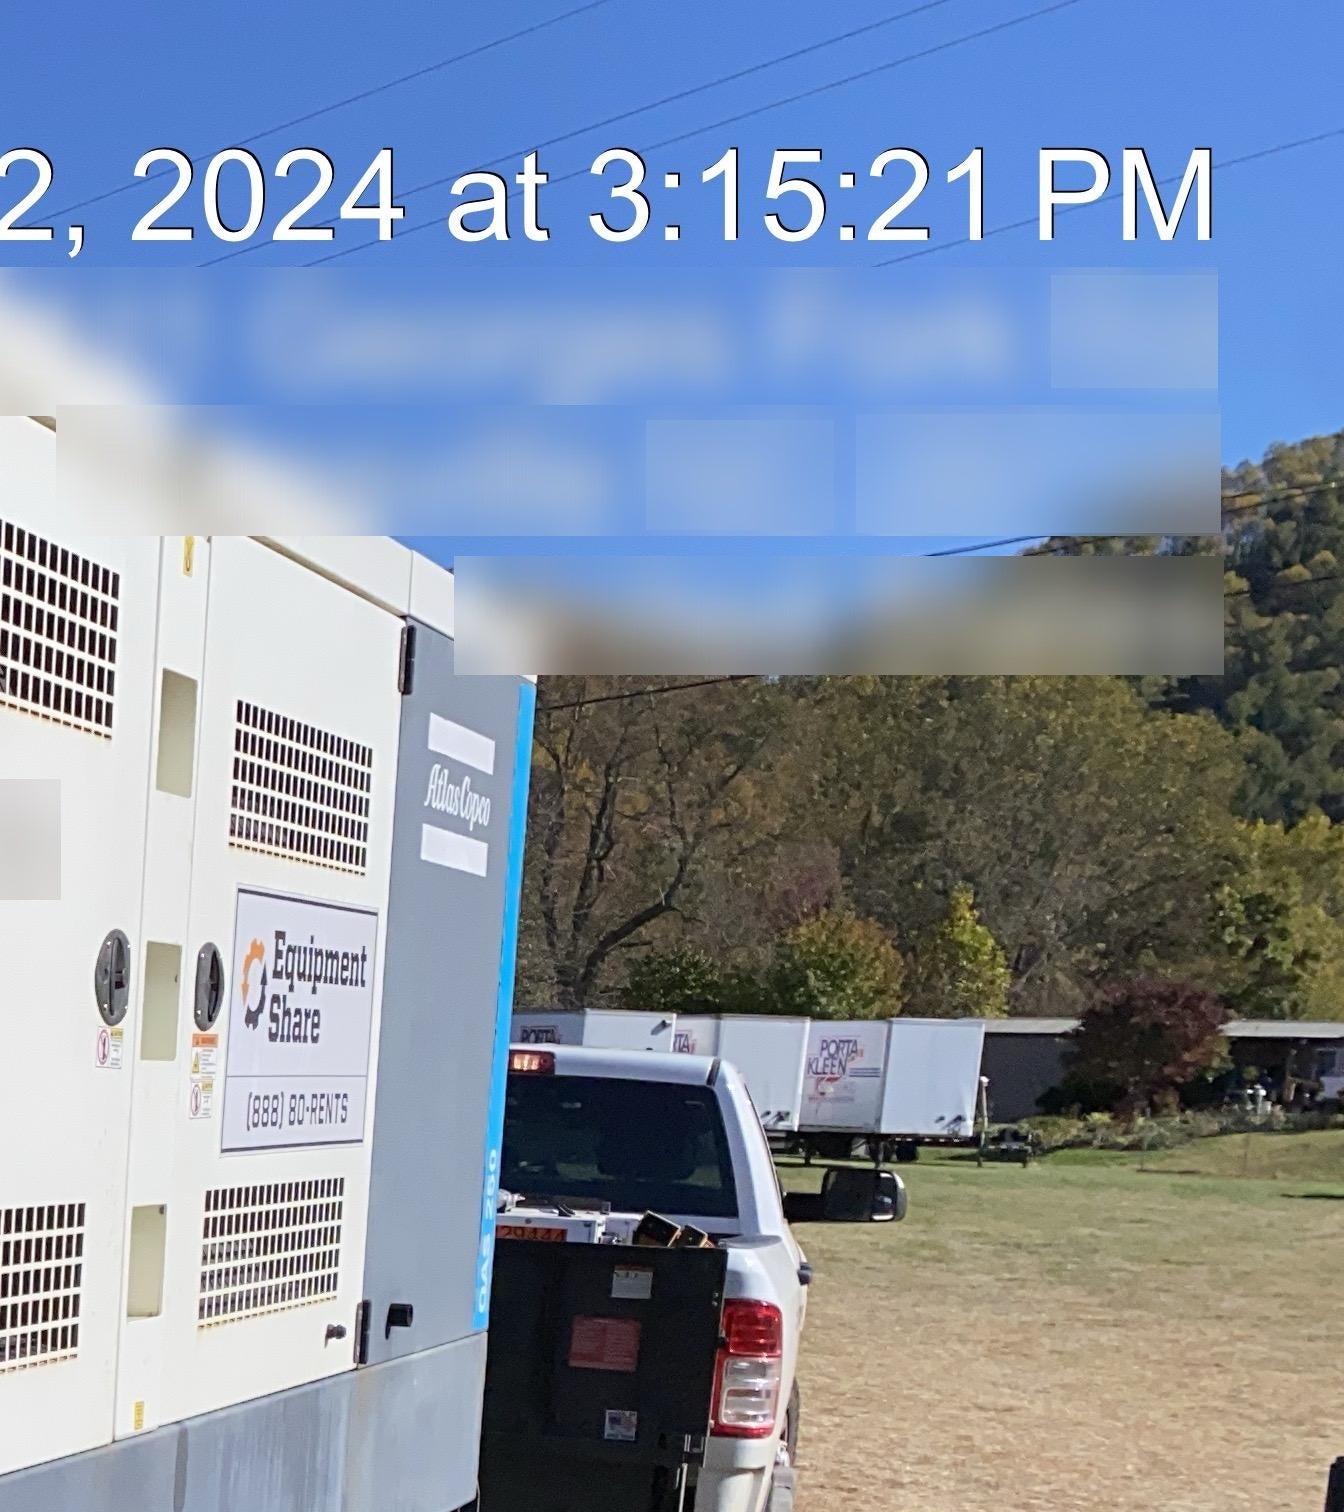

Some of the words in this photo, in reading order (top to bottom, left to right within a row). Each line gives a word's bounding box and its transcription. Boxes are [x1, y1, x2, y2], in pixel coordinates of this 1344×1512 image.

[272, 930, 367, 995] Equipment
[268, 993, 321, 1044] Share
[808, 1057, 847, 1075] KLEEN
[819, 1039, 859, 1058] PORTA
[246, 1091, 284, 1131] (888)
